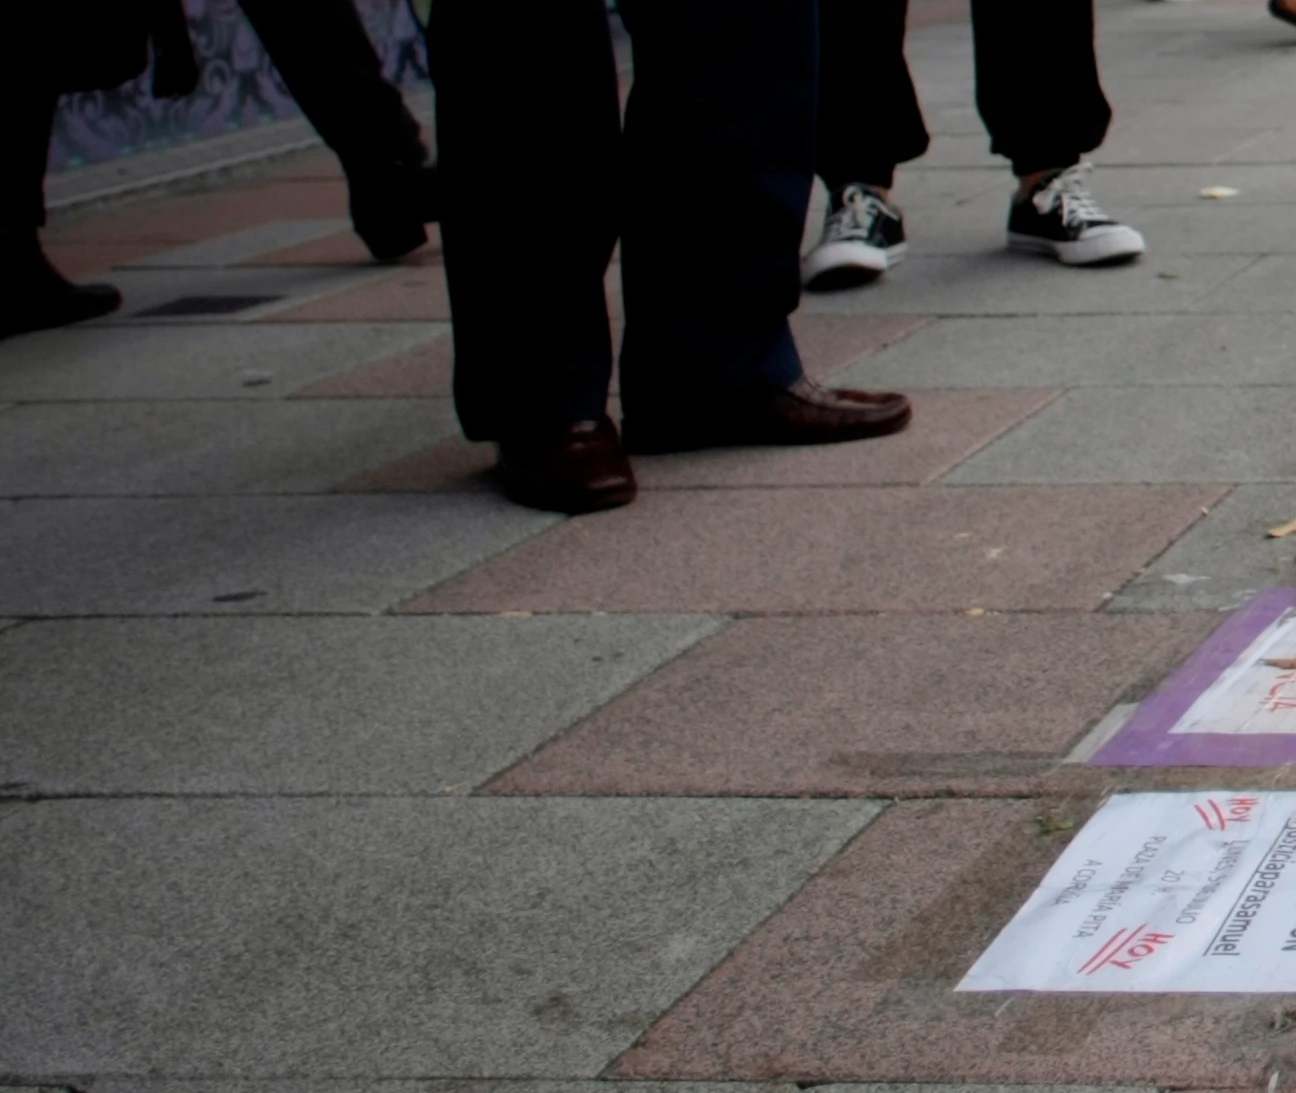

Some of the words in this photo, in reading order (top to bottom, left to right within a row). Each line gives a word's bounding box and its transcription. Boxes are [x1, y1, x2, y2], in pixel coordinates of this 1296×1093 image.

[1226, 798, 1259, 823] HOY
[1134, 836, 1166, 863] PLAZA
[1117, 866, 1144, 879] DE
[1158, 870, 1185, 882] 20
[1096, 882, 1134, 910] MARÍA
[1072, 914, 1108, 937] PITA
[1110, 931, 1174, 970] HOY
